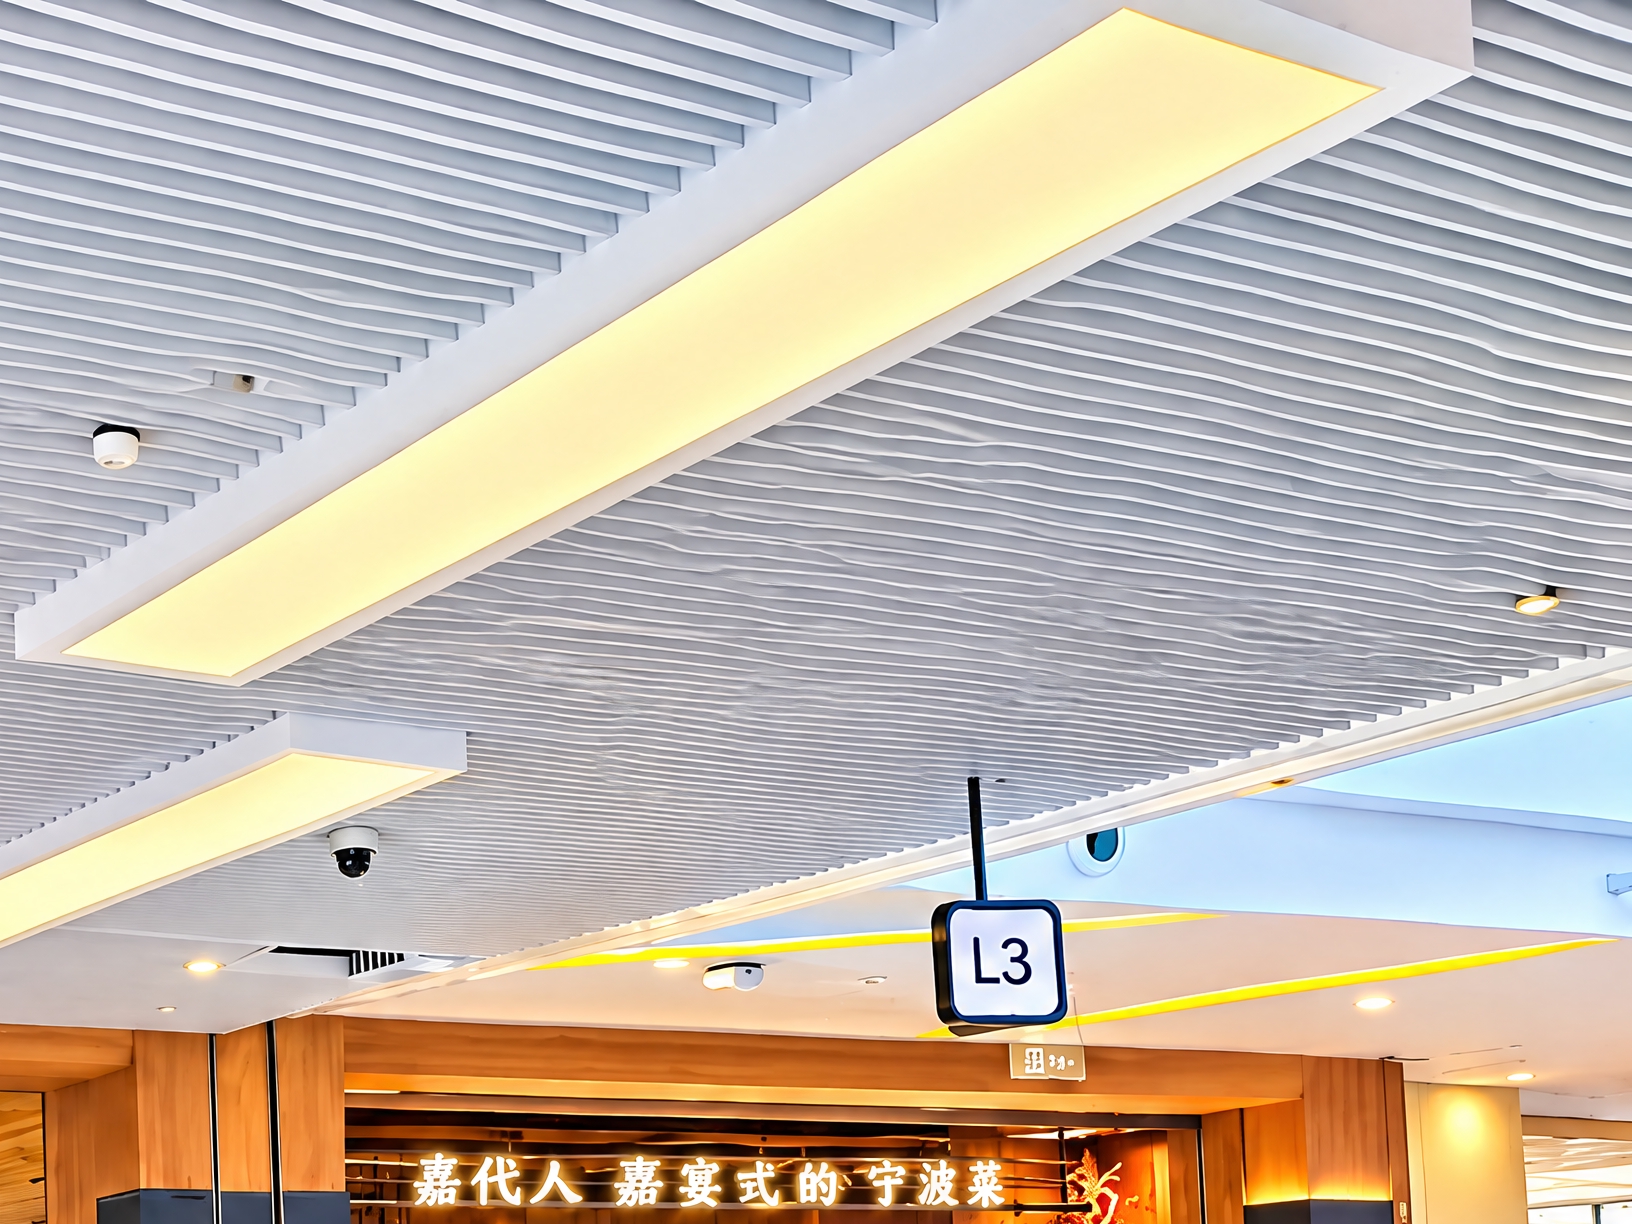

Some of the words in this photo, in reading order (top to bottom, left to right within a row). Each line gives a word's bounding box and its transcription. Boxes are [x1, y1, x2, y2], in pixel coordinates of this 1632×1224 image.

[973, 937, 1032, 985] L3
[413, 1152, 583, 1206] 嘉代人
[613, 1156, 838, 1207] 嘉宴式的
[867, 1160, 1006, 1208] 宁波菜
